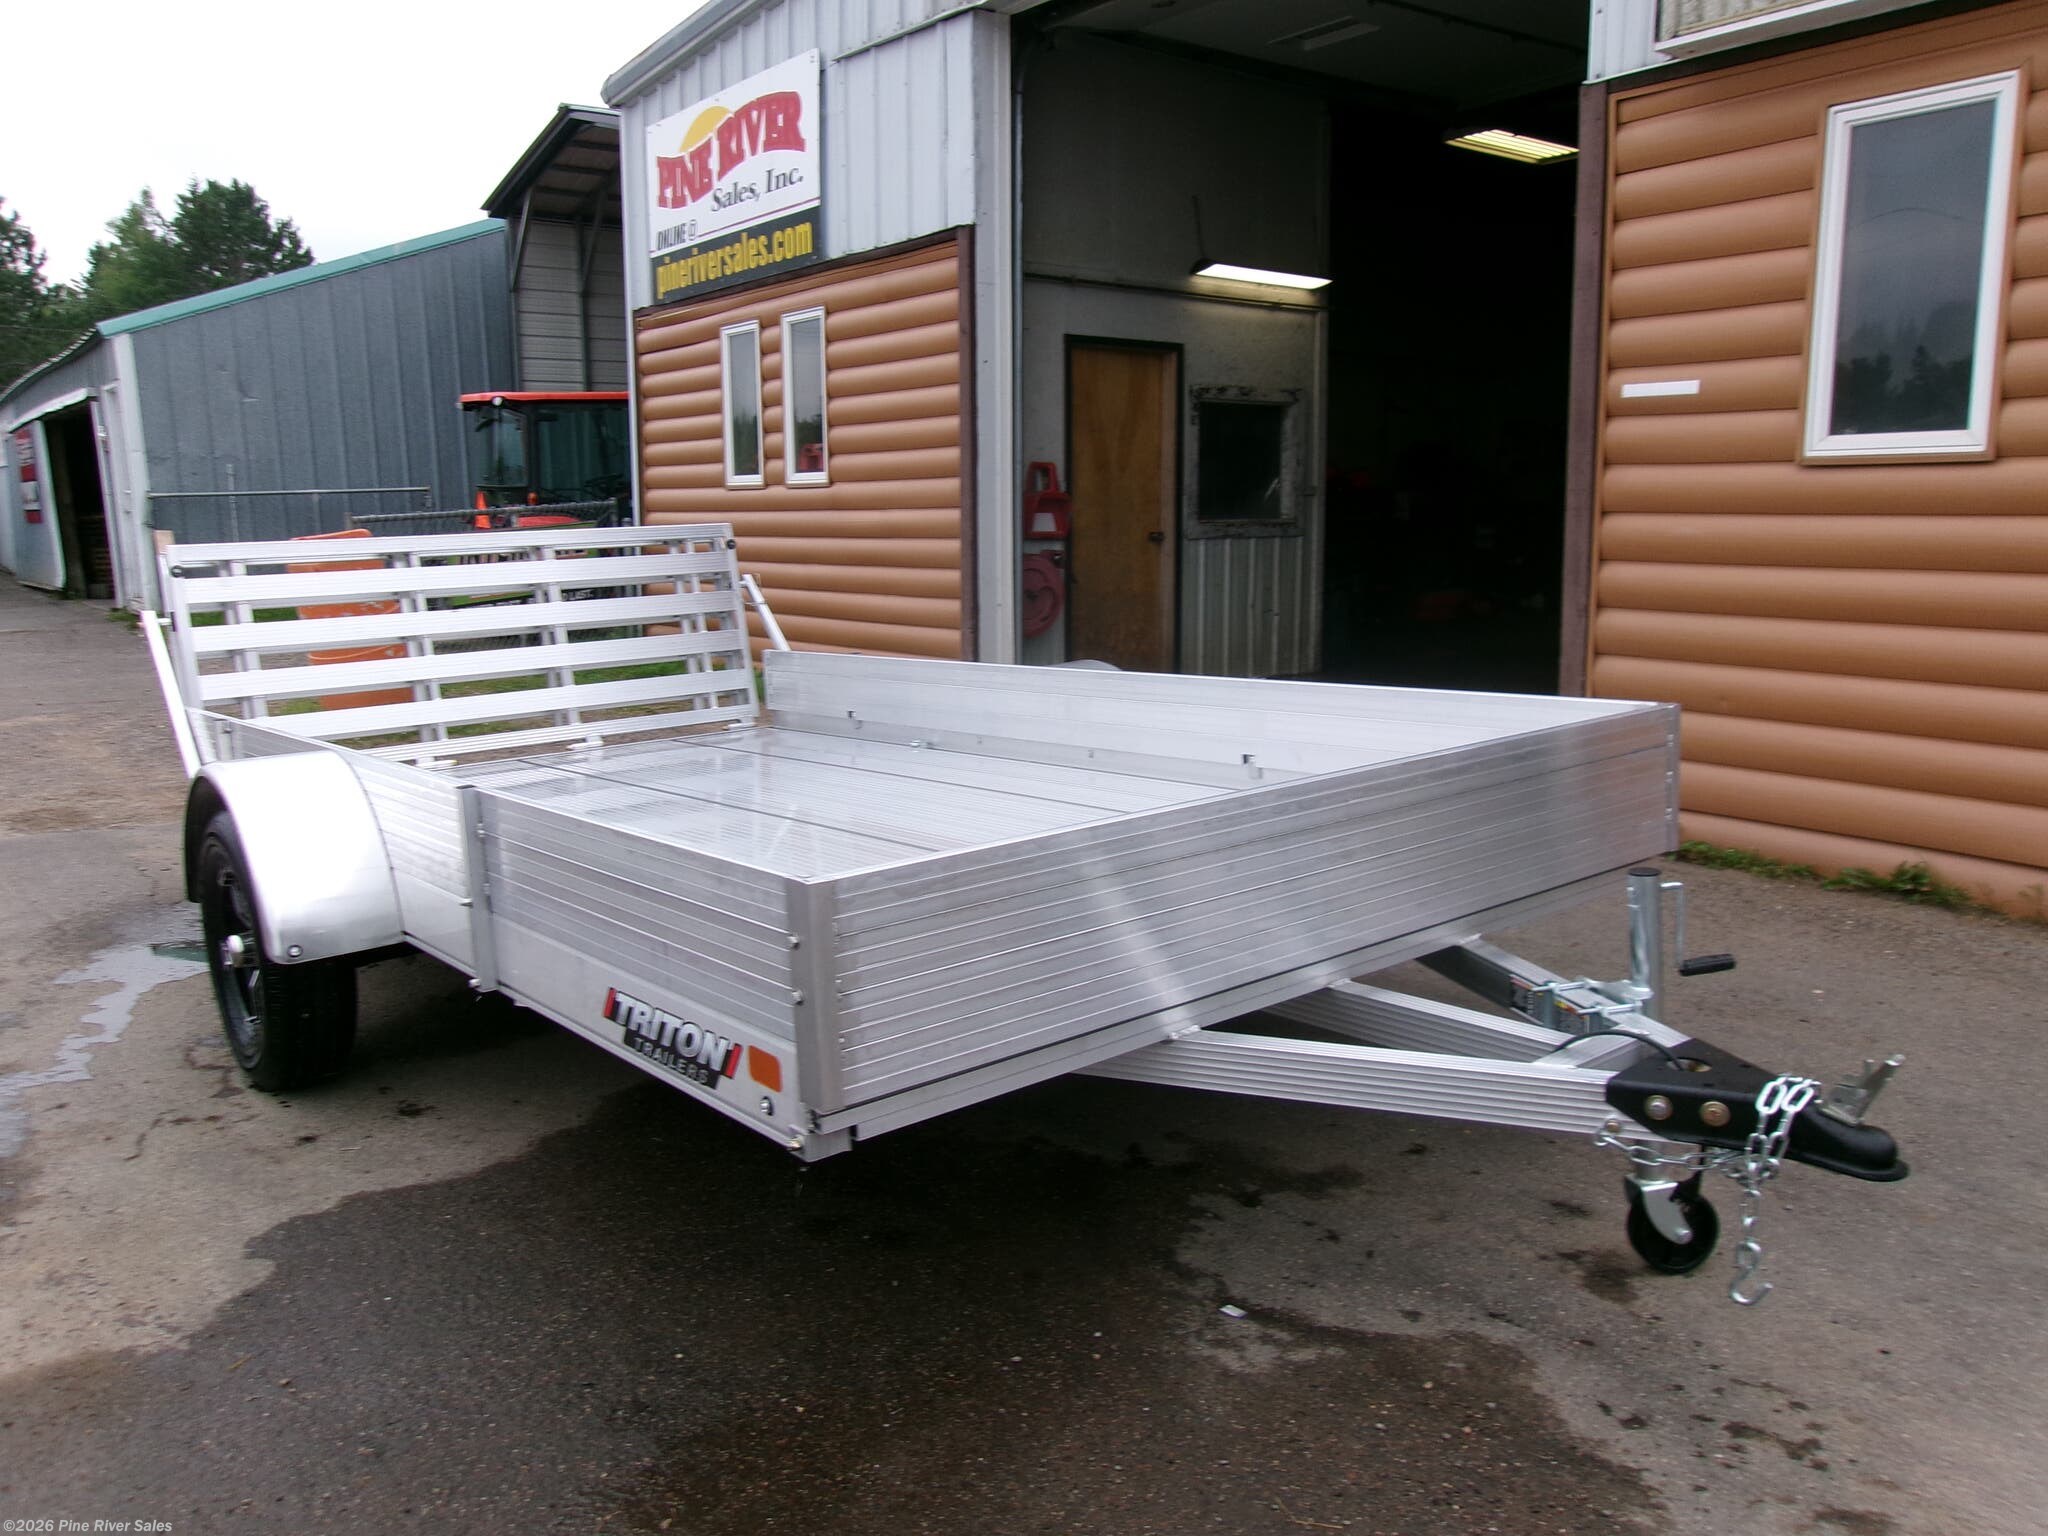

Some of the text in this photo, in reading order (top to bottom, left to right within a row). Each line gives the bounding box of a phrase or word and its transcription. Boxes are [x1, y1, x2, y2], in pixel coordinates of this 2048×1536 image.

[657, 91, 806, 209] PINE RIVER
[711, 167, 804, 212] Sales, Inc.
[657, 222, 687, 250] ONLINE
[657, 222, 813, 299] pineriversales.com
[614, 990, 730, 1072] TRITON
[633, 1036, 709, 1084] TRAILERS
